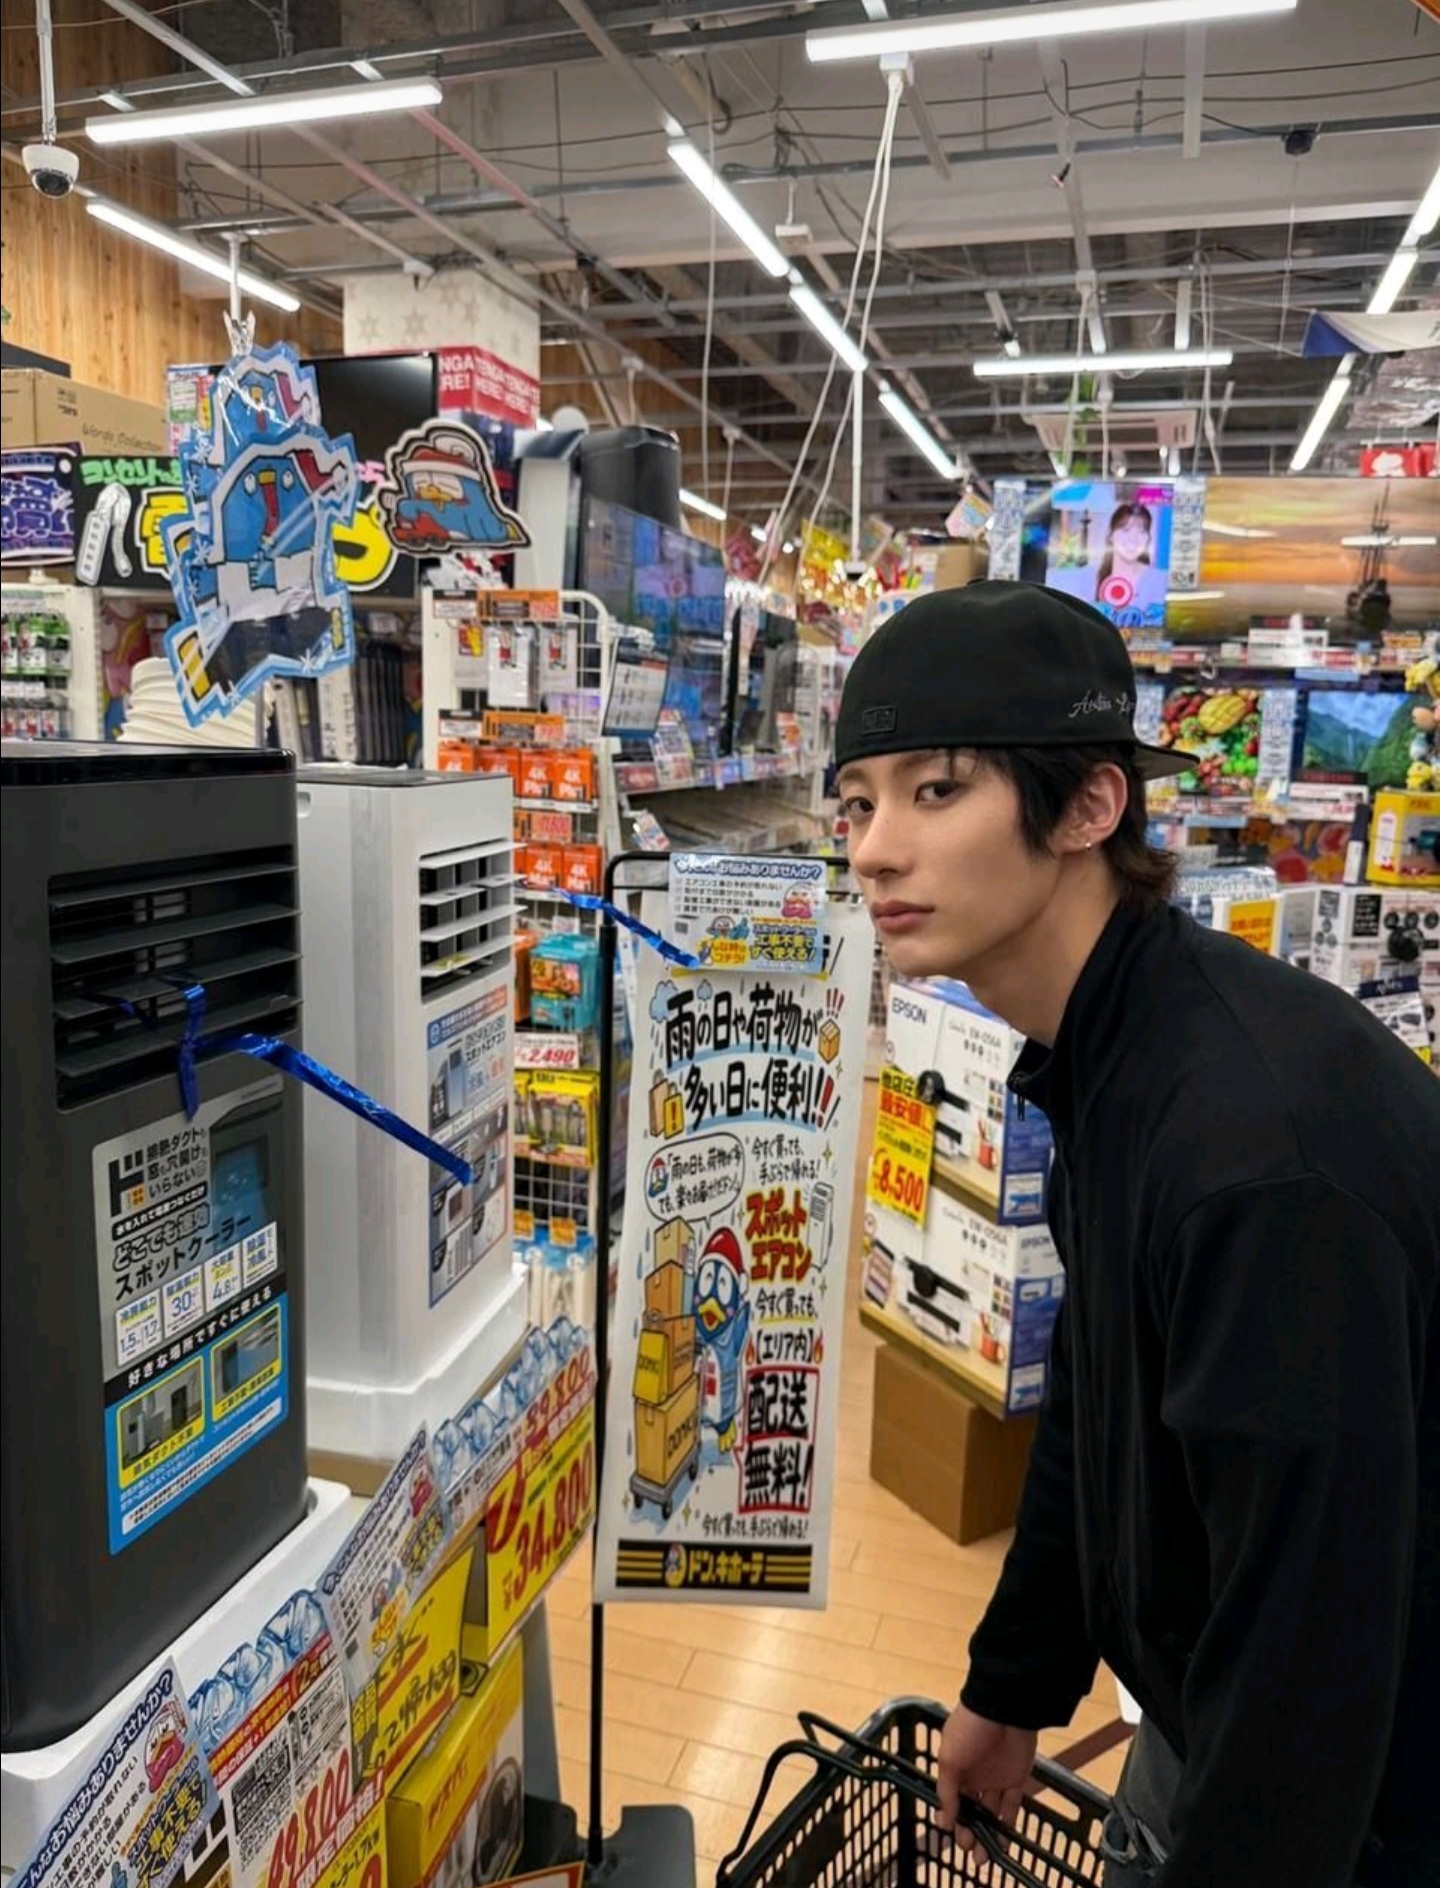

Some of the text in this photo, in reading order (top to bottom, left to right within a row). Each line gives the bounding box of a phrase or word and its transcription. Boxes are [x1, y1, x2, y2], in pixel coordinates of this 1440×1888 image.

[665, 982, 824, 1068] 雨の日や荷物が
[892, 996, 928, 1027] EPSON
[685, 1057, 835, 1131] 多い日に便利!!
[149, 1167, 197, 1198] いらない
[745, 1186, 808, 1241] スポット
[116, 1215, 252, 1302] スポットクーラー
[749, 1237, 813, 1283] エアコン
[172, 1290, 194, 1318] 30
[128, 1285, 273, 1389] 好きな場所ですぐに使える
[754, 1330, 815, 1365] 【エリア内】
[747, 1371, 810, 1437] 配送
[744, 1444, 815, 1507] 無料!
[45, 1756, 139, 1888] 工事の予約が取れない
